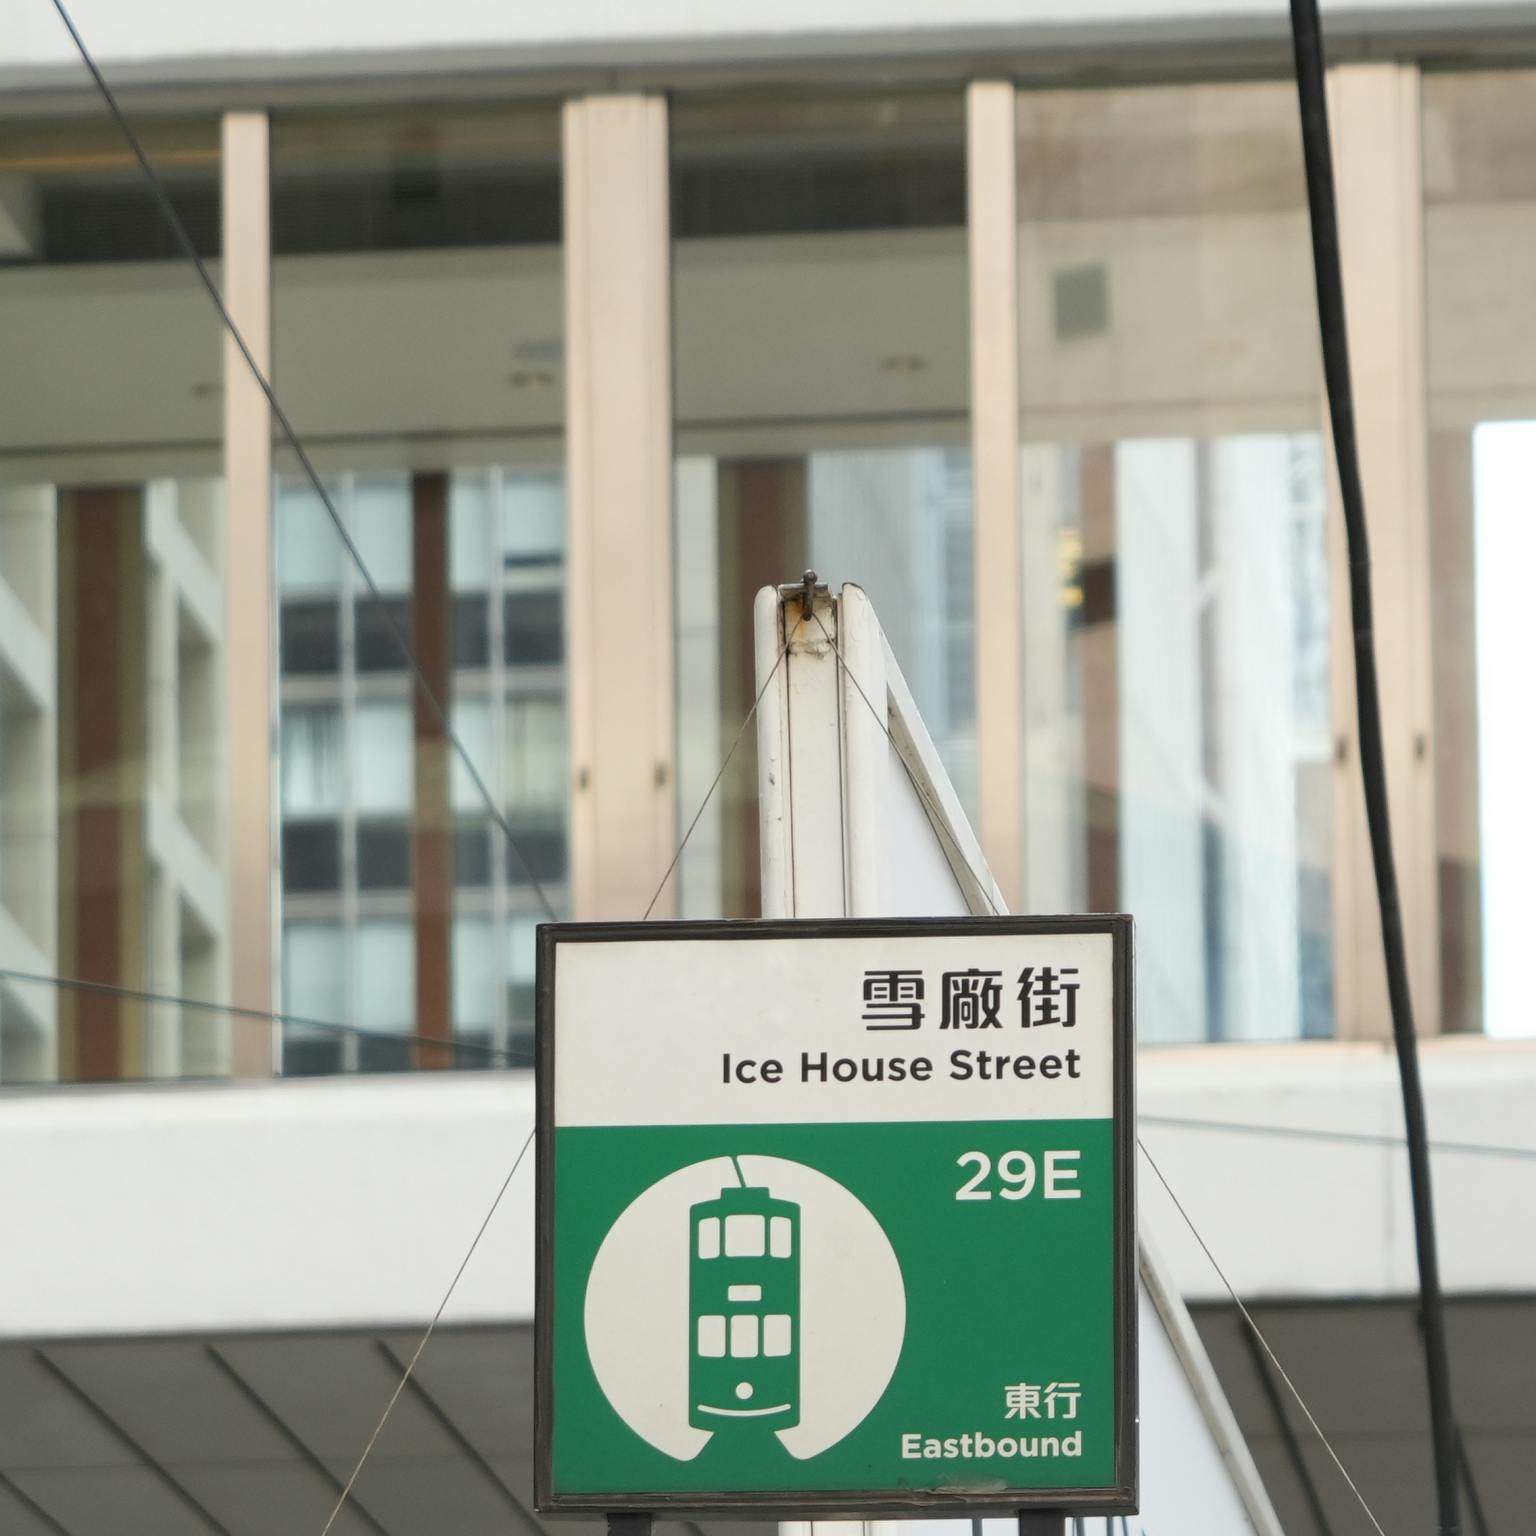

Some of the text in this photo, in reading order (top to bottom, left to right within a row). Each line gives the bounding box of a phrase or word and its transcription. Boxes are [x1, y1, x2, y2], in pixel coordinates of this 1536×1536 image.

[862, 966, 1081, 1031] 雪廠街
[722, 1048, 1081, 1084] Ice House Street
[955, 1149, 1082, 1201] 29E
[1004, 1381, 1082, 1420] 東行
[901, 1431, 1083, 1459] Eastbound
